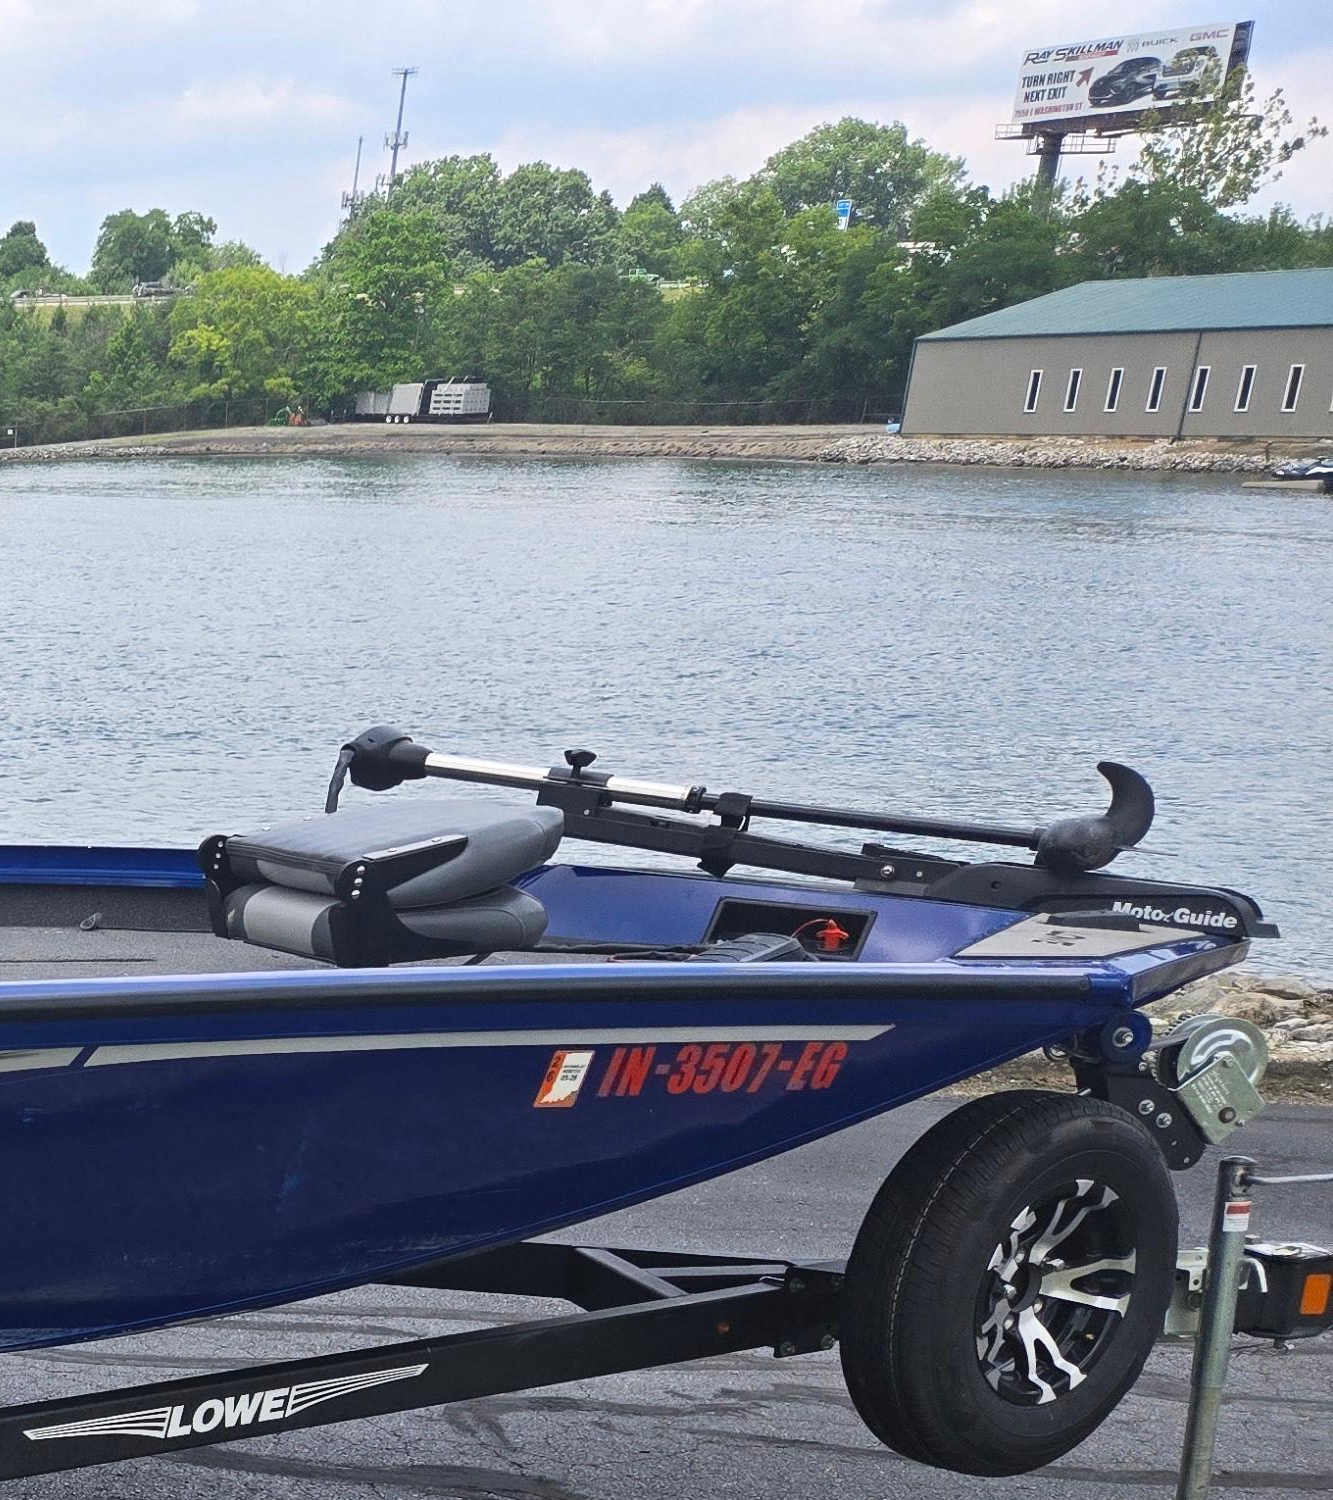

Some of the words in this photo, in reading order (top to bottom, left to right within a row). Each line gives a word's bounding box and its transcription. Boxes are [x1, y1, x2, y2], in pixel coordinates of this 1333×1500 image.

[1142, 37, 1179, 47] BUICK
[1190, 29, 1230, 42] GMC
[1023, 49, 1055, 66] RAY
[1053, 40, 1123, 61] SKILLMAN
[1022, 75, 1046, 88] TURN
[1046, 70, 1076, 84] RIGHT
[1023, 89, 1047, 103] NEXT
[1047, 86, 1068, 100] EXIT
[167, 1386, 290, 1439] LOWE
